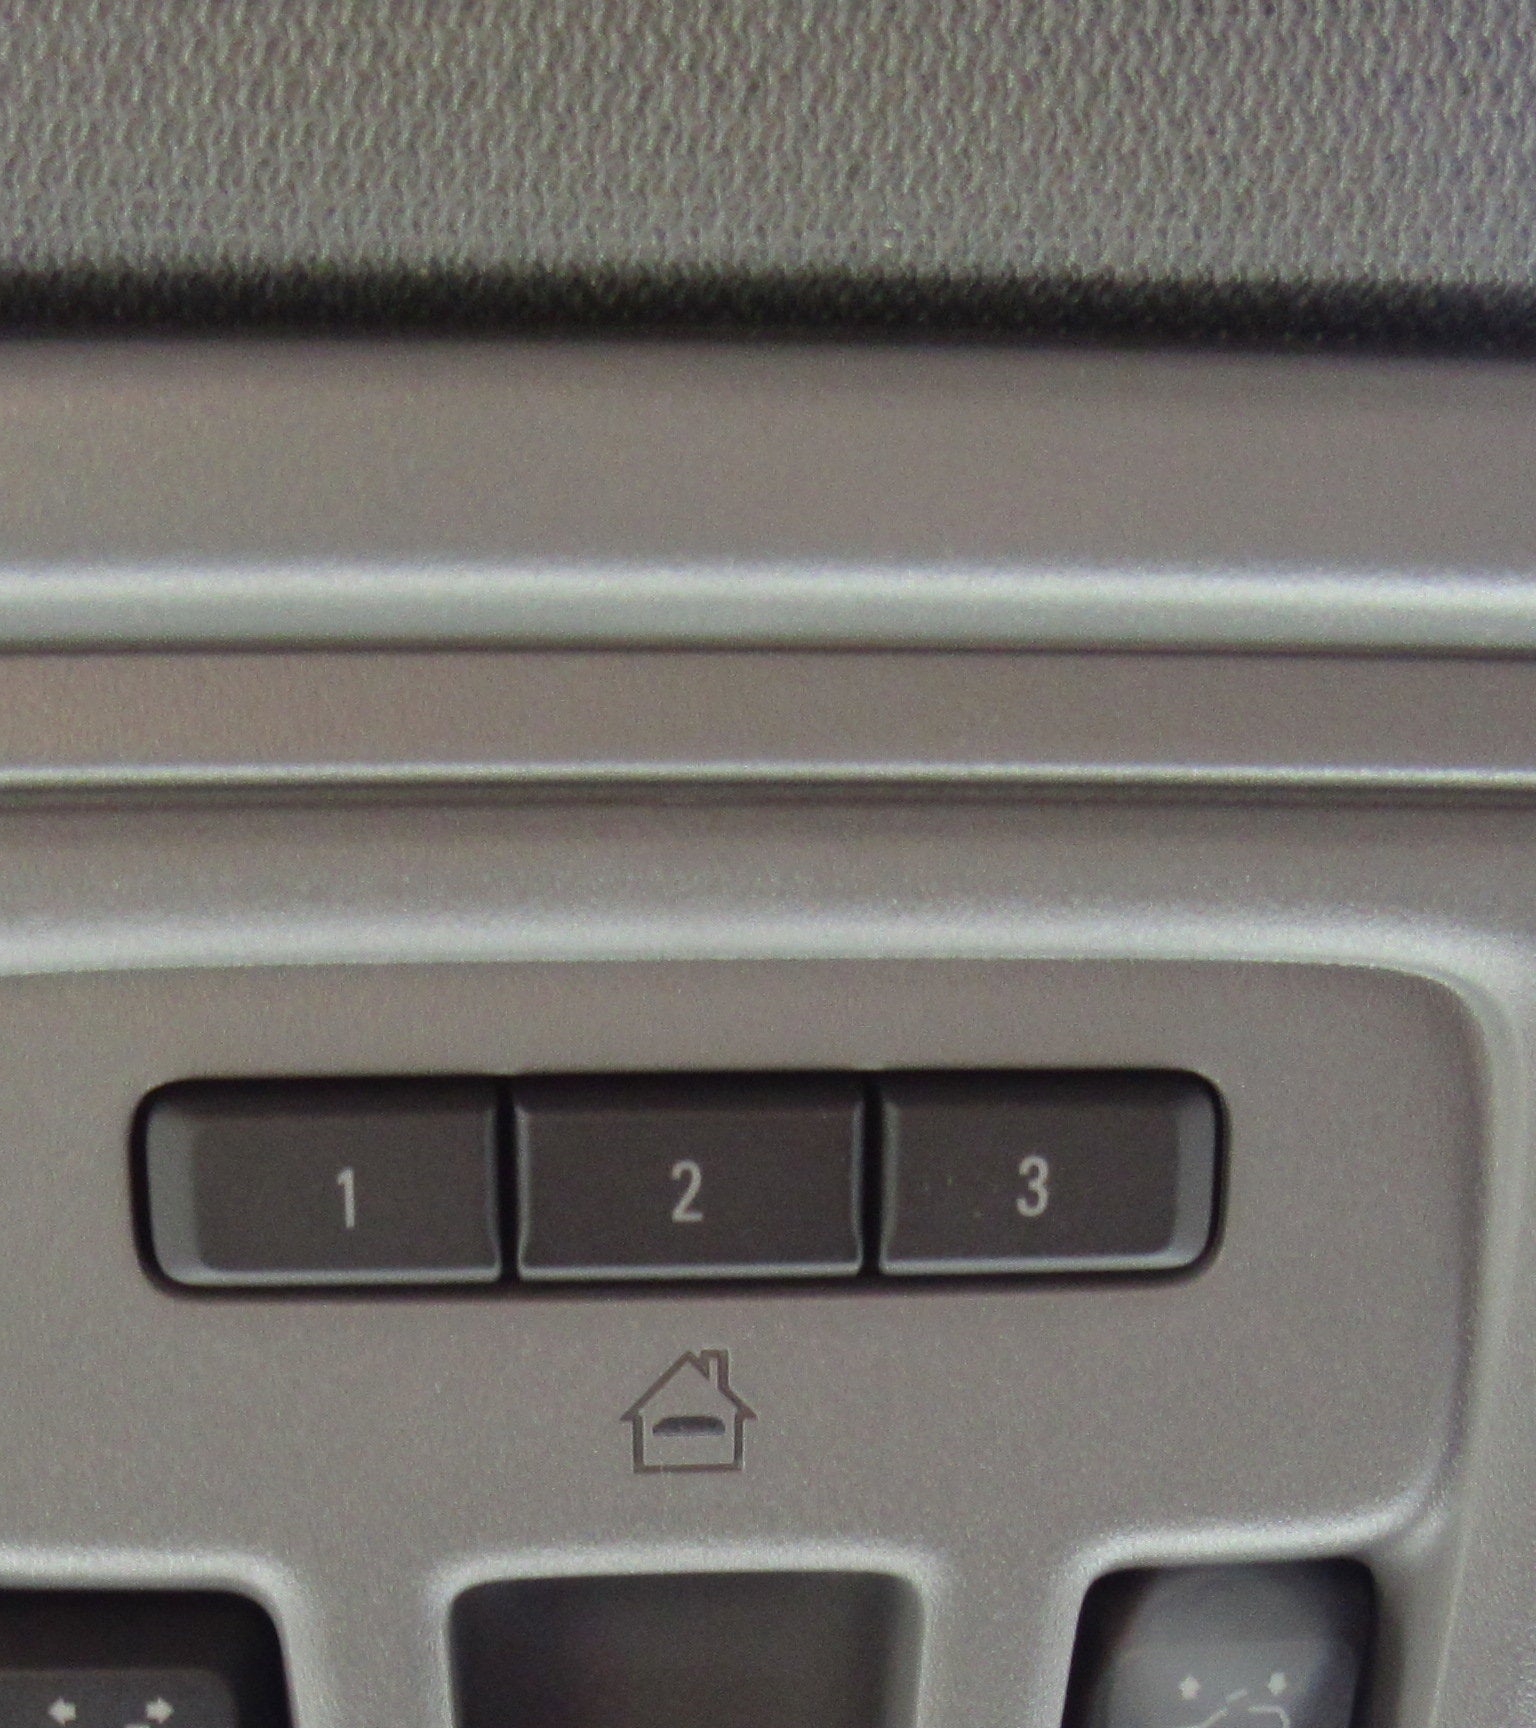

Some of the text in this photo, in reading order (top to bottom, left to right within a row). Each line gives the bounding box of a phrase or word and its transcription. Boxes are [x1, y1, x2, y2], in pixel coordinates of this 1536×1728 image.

[336, 1168, 356, 1228] 1
[670, 1160, 704, 1222] 2
[1016, 1156, 1050, 1216] 3
